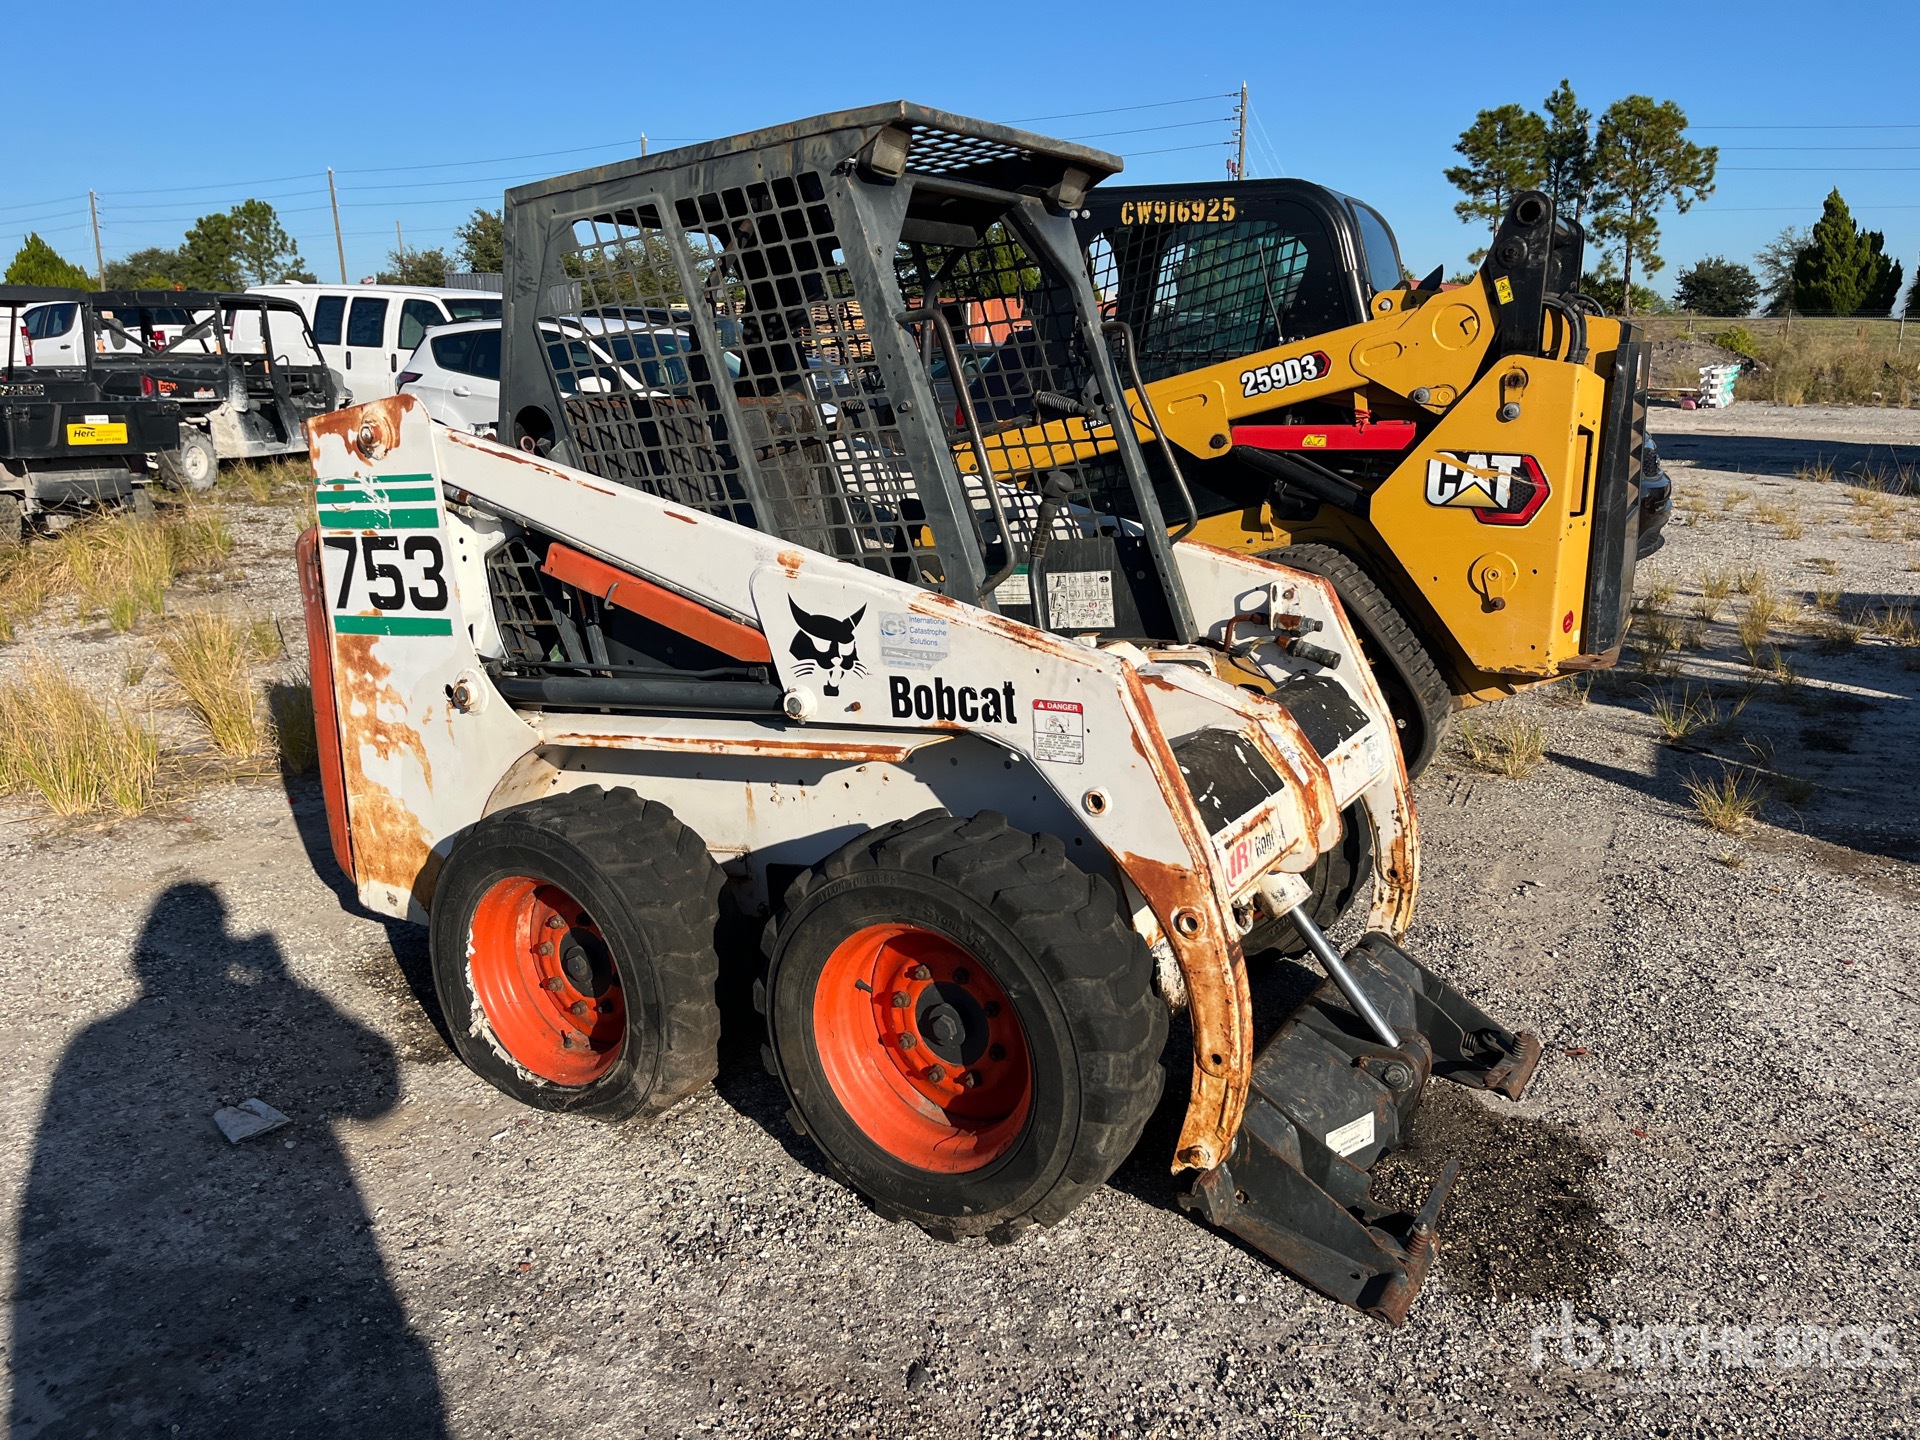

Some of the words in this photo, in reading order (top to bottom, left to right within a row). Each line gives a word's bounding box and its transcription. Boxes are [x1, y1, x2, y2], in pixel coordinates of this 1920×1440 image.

[1121, 197, 1236, 225] CW916925
[1240, 353, 1318, 398] 259D3
[1426, 451, 1521, 509] CAT
[322, 535, 449, 611] 753
[909, 615, 947, 626] International
[909, 626, 947, 636] Catastrophe
[909, 636, 938, 646] Solutions
[889, 675, 1017, 724] Bobcat
[1047, 702, 1078, 711] DANGER
